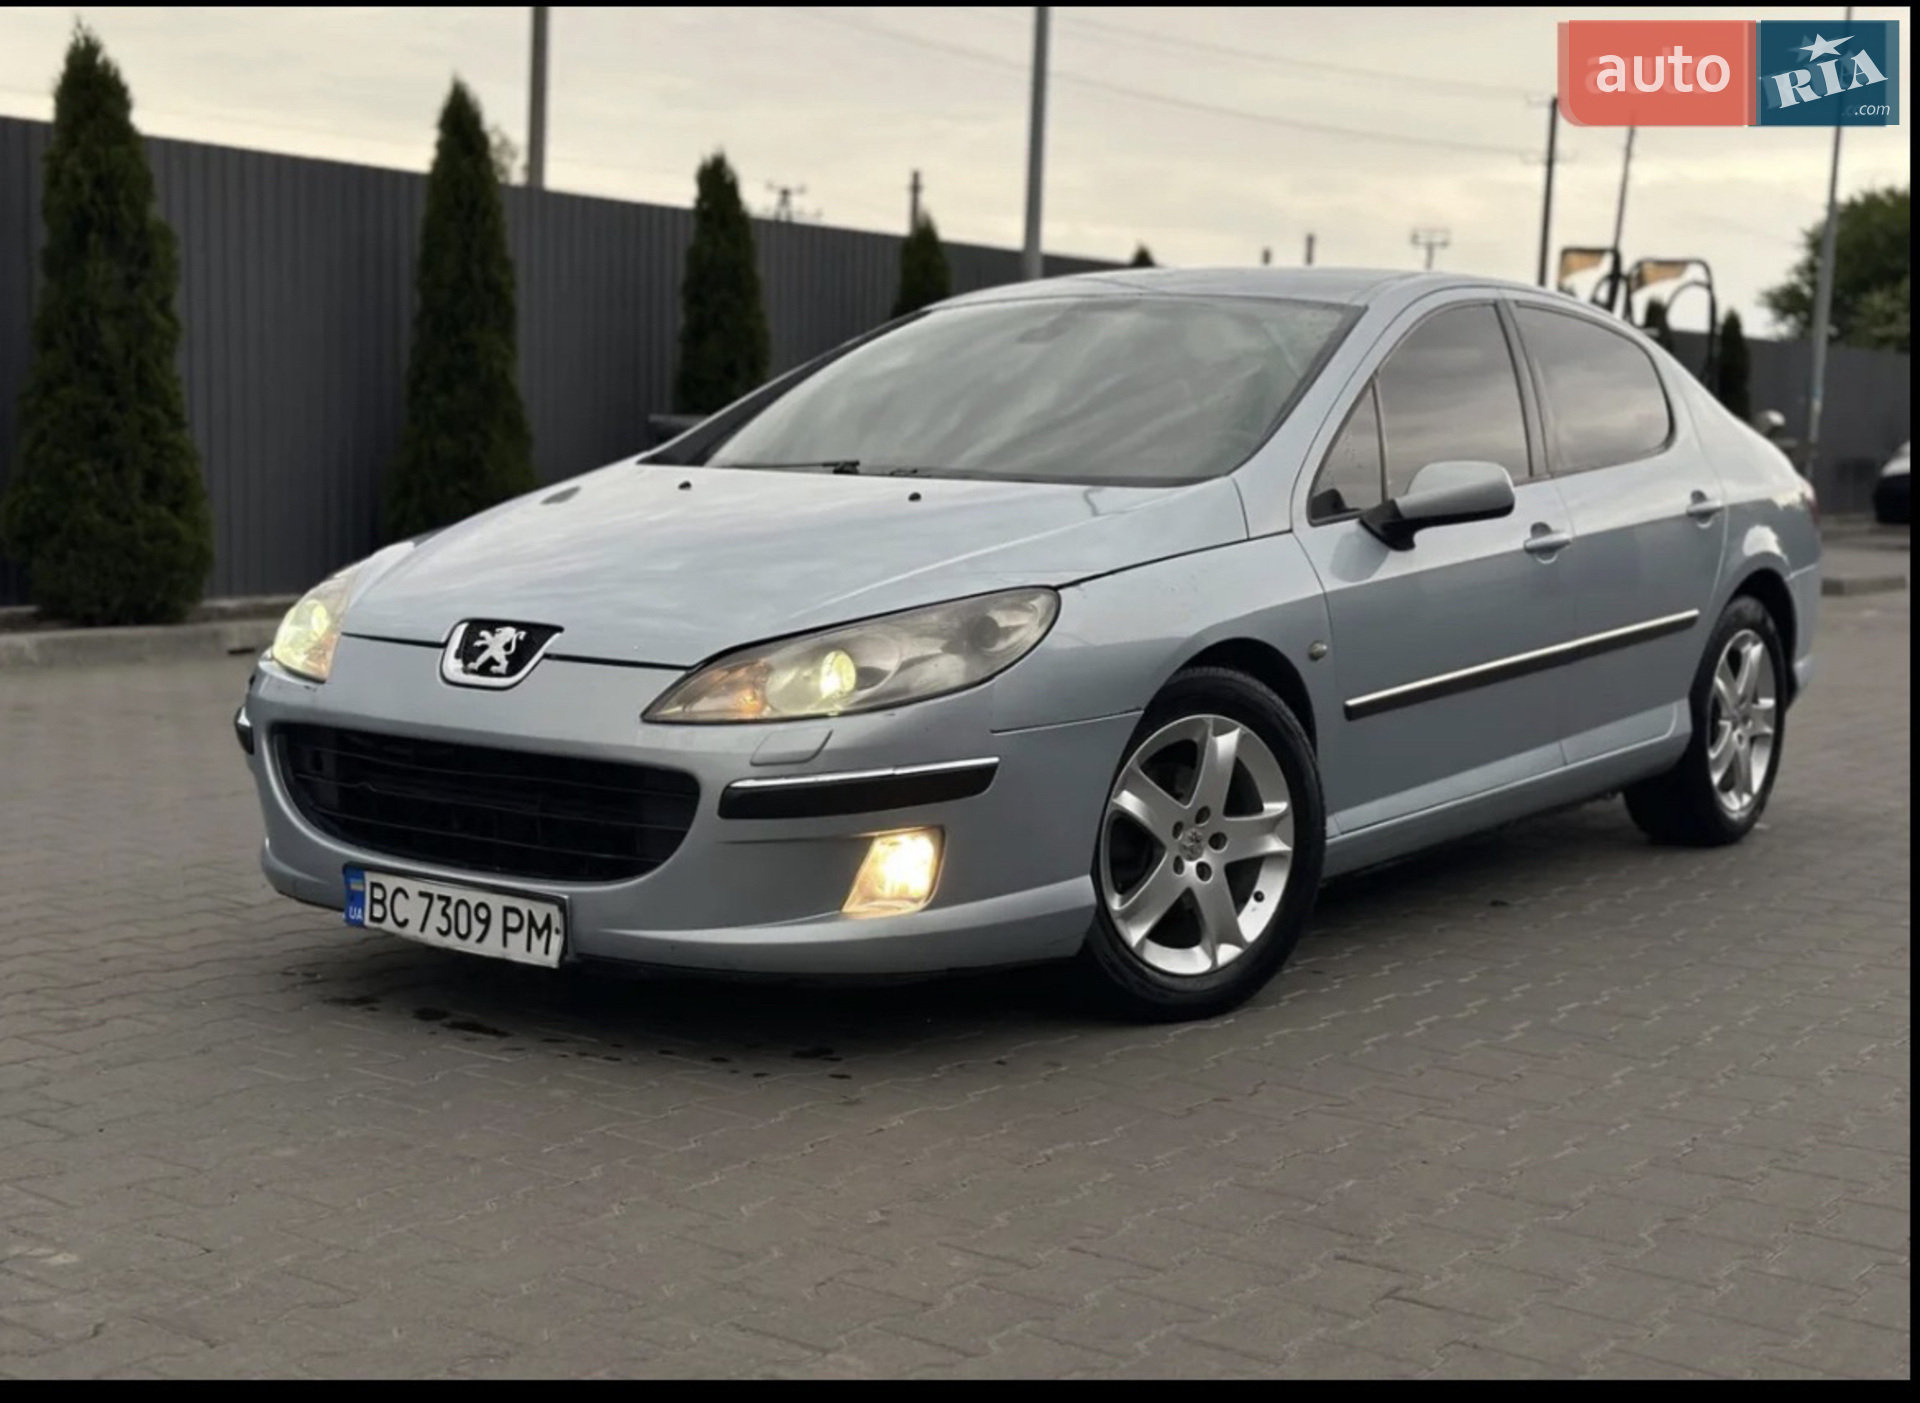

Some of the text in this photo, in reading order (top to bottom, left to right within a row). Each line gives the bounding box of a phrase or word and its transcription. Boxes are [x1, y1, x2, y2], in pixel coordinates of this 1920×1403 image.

[349, 905, 363, 920] UA
[368, 881, 552, 955] BC 7309 PM
